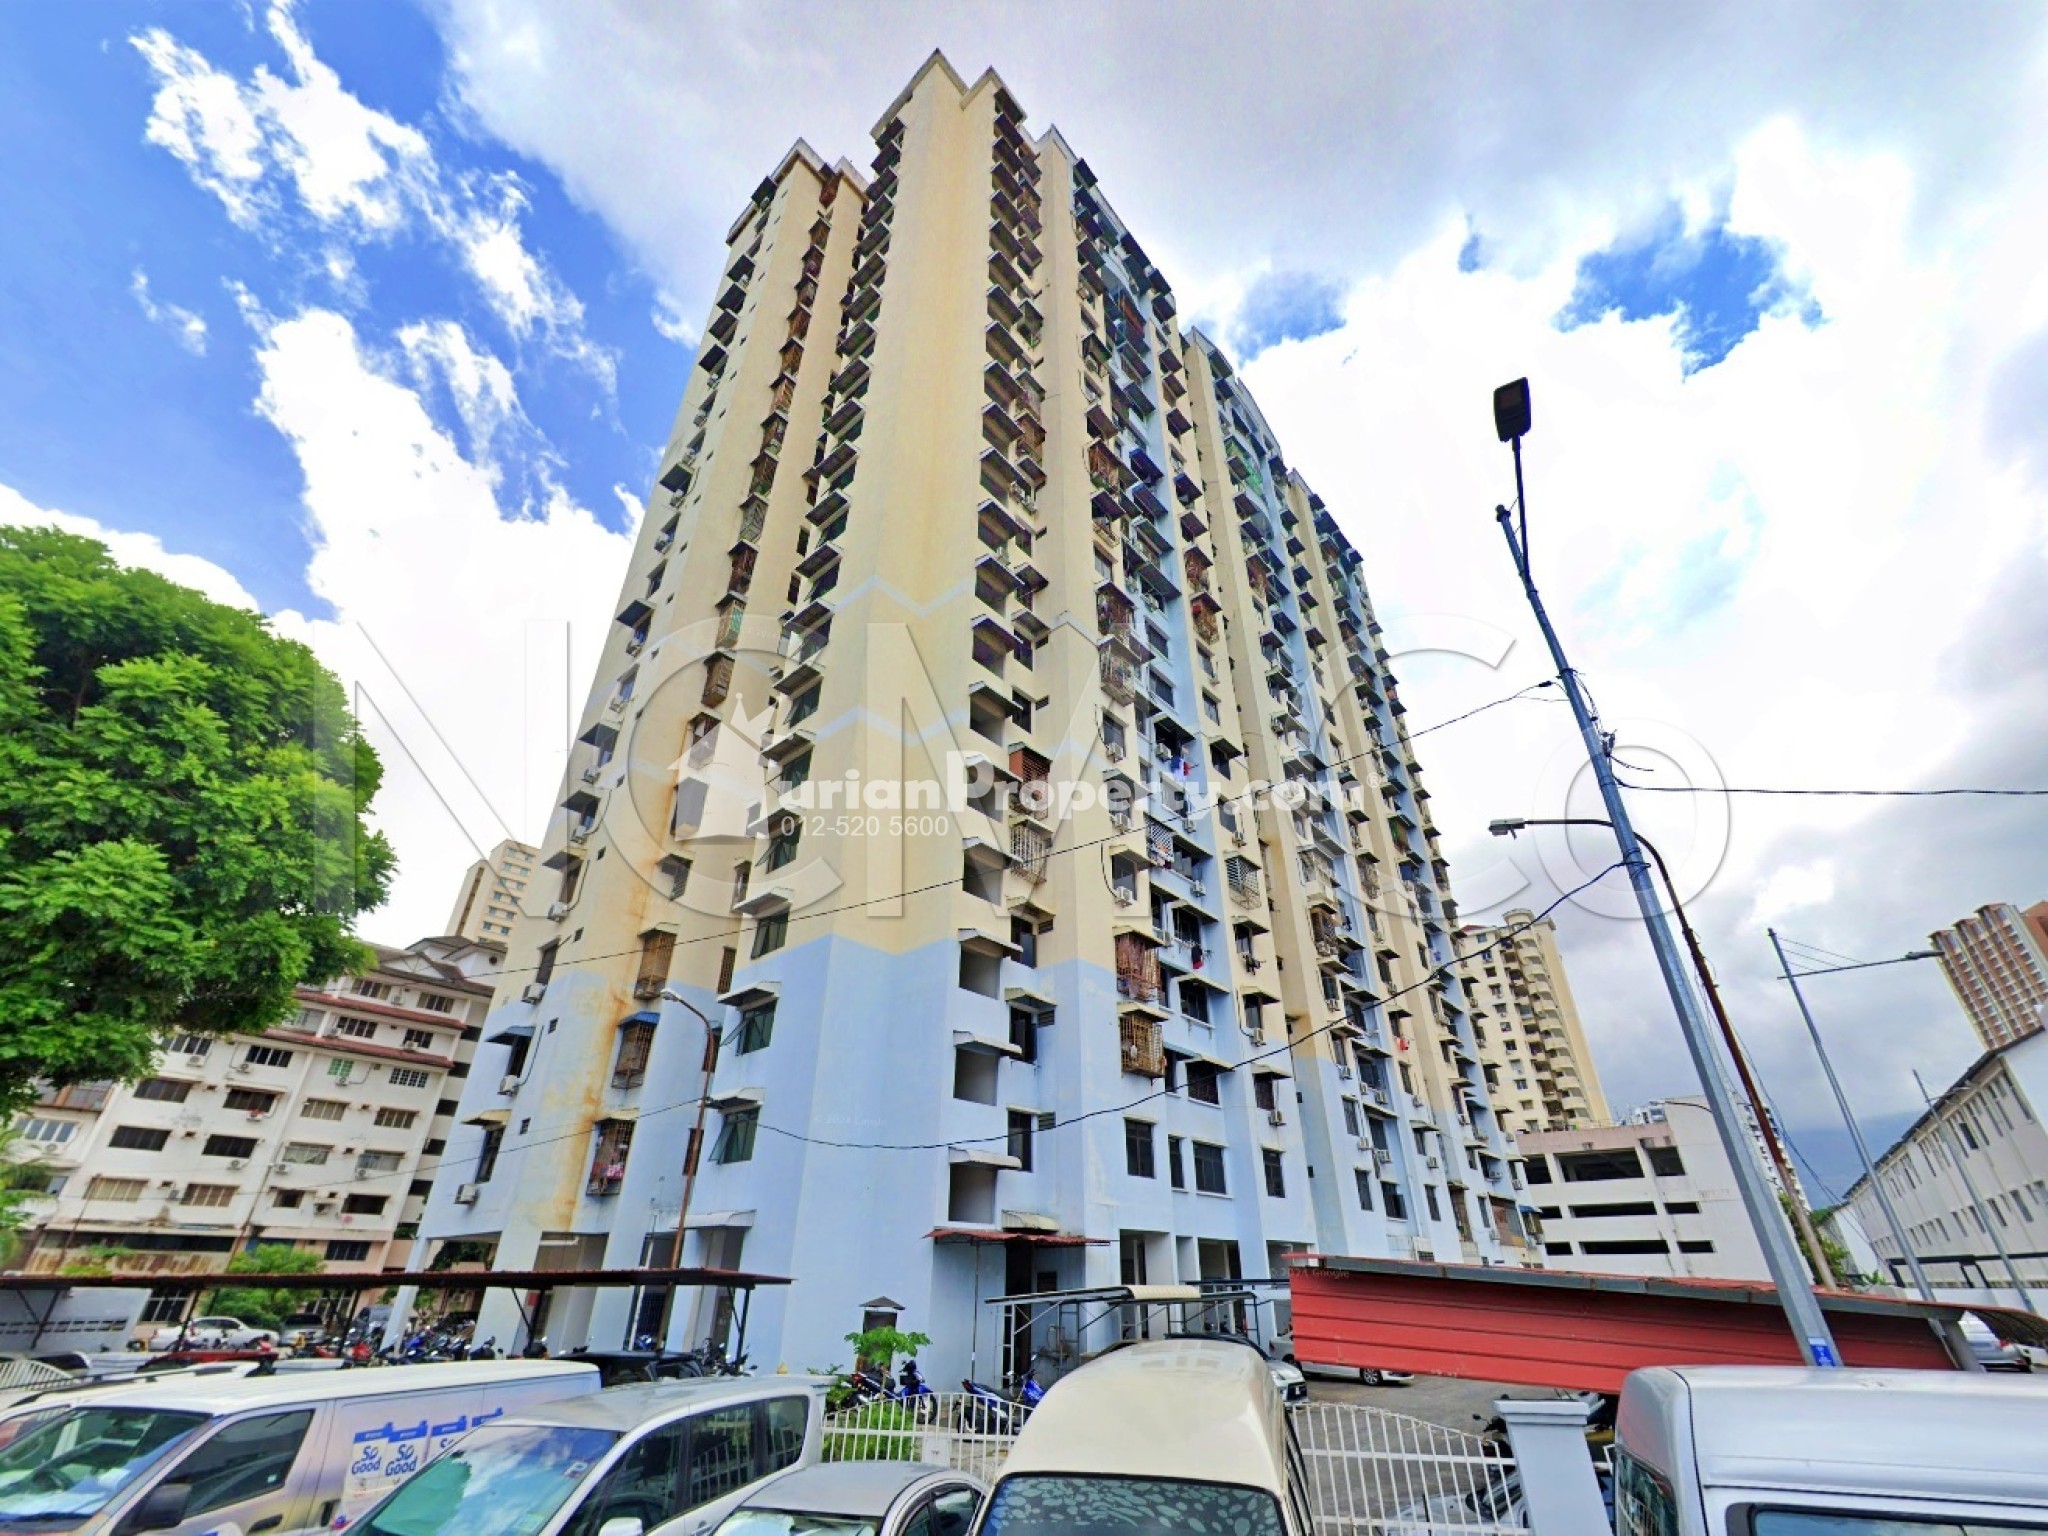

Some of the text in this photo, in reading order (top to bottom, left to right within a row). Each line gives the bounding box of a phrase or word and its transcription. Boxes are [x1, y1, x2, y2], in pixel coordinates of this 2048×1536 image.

[361, 1445, 379, 1461] So
[396, 1443, 415, 1461] So
[351, 1456, 382, 1475] Good
[385, 1455, 418, 1476] Good
